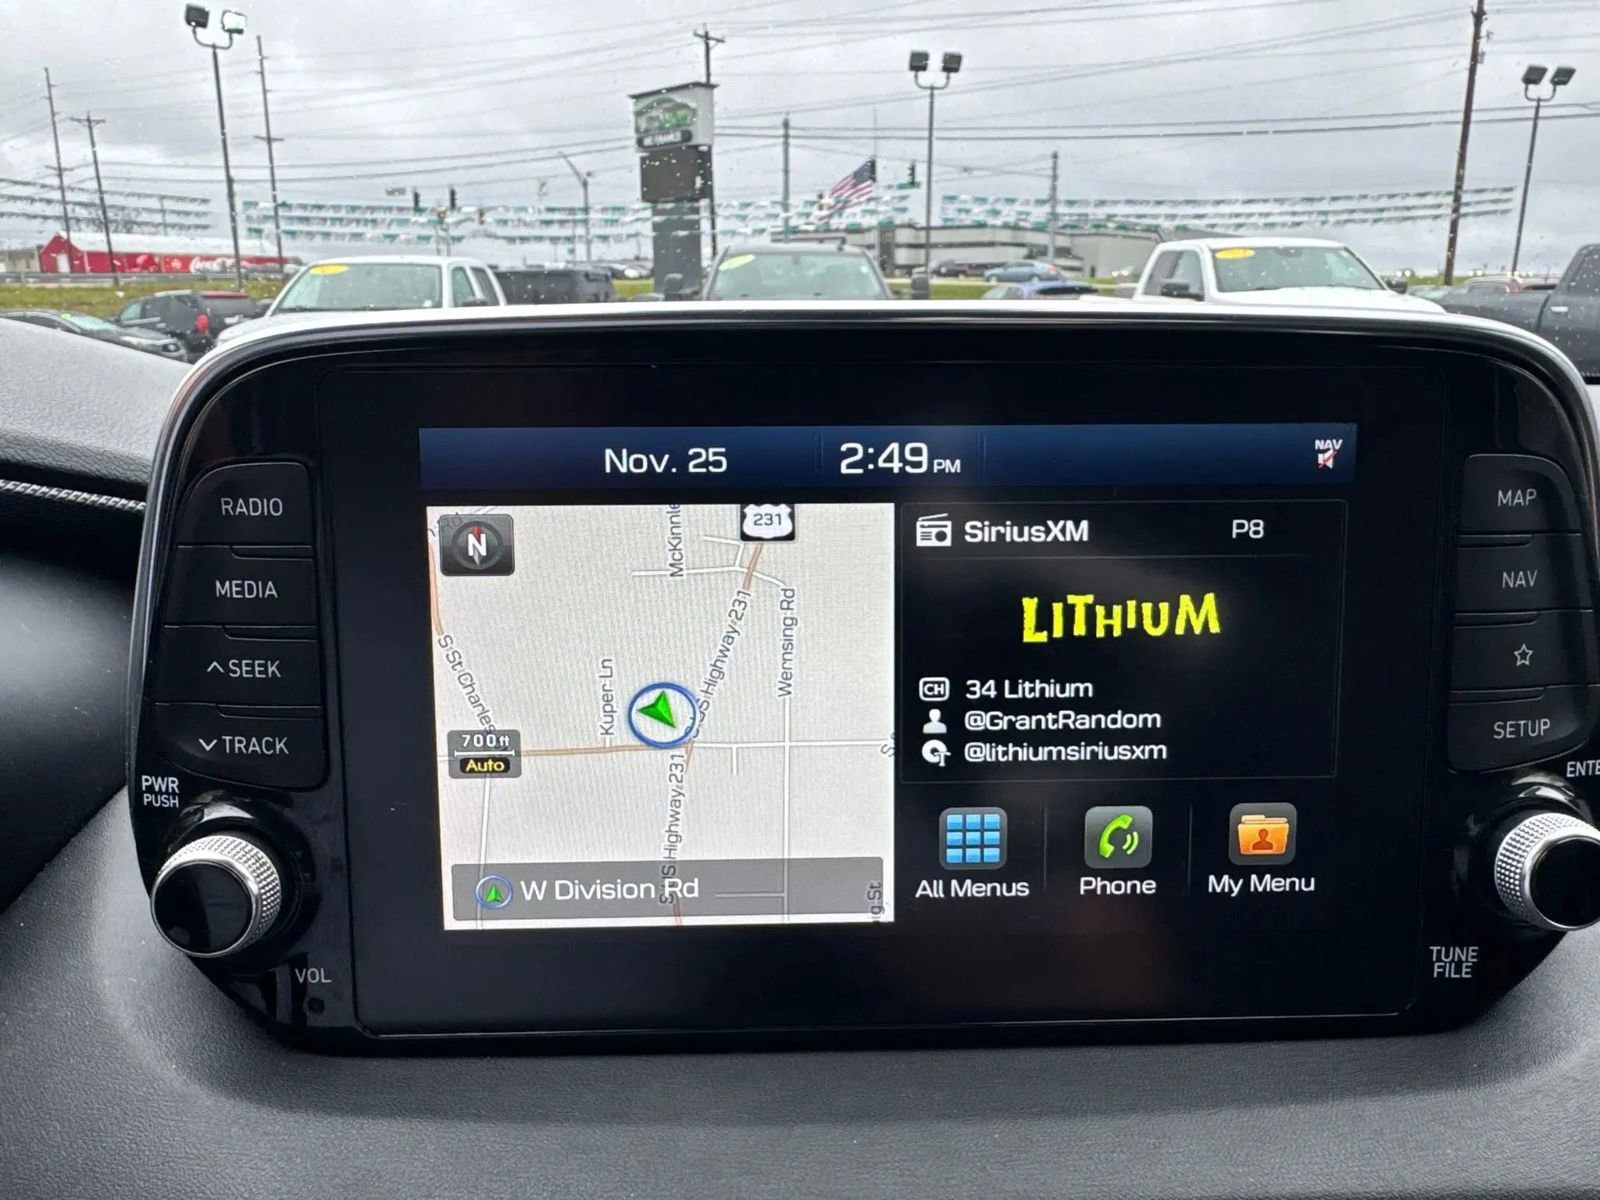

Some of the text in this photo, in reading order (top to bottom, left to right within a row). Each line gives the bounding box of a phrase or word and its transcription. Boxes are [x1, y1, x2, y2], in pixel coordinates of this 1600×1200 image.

[1314, 439, 1343, 450] NAV
[604, 447, 728, 473] Nov. 25
[840, 441, 961, 475] 2:49 PM
[220, 497, 283, 516] RADIO
[1497, 488, 1537, 508] MAP
[753, 513, 782, 527] 231
[1231, 518, 1265, 540] P8
[963, 520, 1090, 543] SiriusXM
[468, 533, 487, 557] N
[214, 579, 279, 599] MEDIA
[1502, 570, 1538, 589] NAV
[780, 588, 796, 611] Rd
[438, 634, 454, 649] S
[700, 624, 741, 696] Highway
[728, 589, 751, 622] 231
[228, 659, 282, 678] SEEK
[445, 650, 464, 672] St
[598, 658, 618, 736] Kuper Ln
[924, 679, 1094, 699] CH 34 Lithium
[964, 708, 1162, 732] @GrantRandom
[1493, 718, 1551, 740] SETUP
[221, 735, 289, 755] TRACK
[964, 741, 1168, 762] @lithiumsiriusxm
[465, 759, 505, 772] Auto
[669, 754, 685, 784] 231
[1566, 760, 1600, 778] ENTE
[141, 775, 180, 794] PWR
[143, 793, 180, 809] PUSH
[664, 789, 686, 860] Highway
[520, 877, 699, 900] W Division Rd
[867, 882, 881, 901] St
[915, 878, 1030, 899] All Menus
[1079, 876, 1157, 896] Phone
[1207, 874, 1316, 896] My Menu
[1429, 946, 1479, 962] TUNE
[294, 967, 332, 984] VOL
[1433, 962, 1473, 979] FILE
